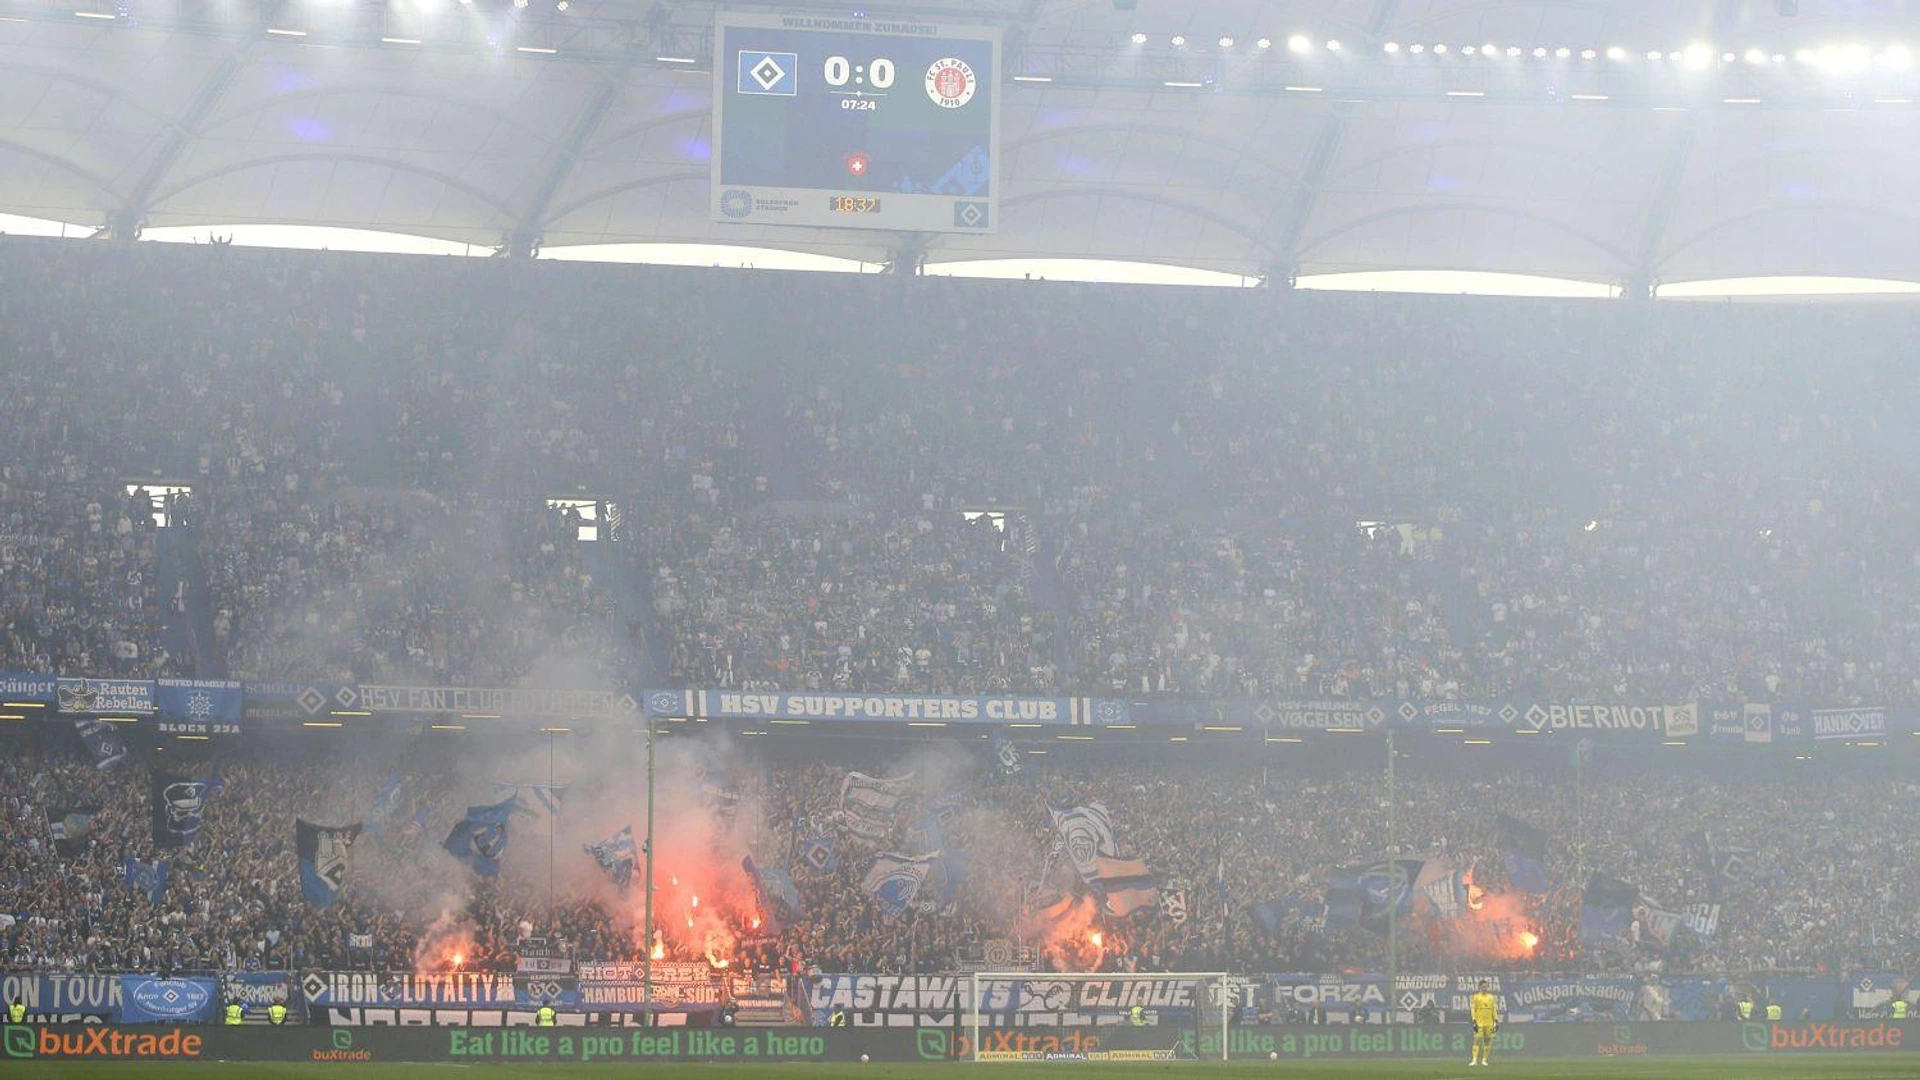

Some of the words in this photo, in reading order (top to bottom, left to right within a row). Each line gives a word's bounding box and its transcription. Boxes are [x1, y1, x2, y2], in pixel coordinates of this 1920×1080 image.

[824, 56, 895, 88] 0:0
[927, 70, 935, 80] FC
[951, 60, 973, 83] PAULI
[841, 100, 876, 110] 07:24
[940, 98, 960, 106] 1910
[836, 197, 876, 212] 18:37
[100, 682, 148, 695] Rauten
[361, 688, 400, 708] HSV
[410, 690, 446, 709] FAN
[96, 696, 152, 709] Rebellen
[721, 694, 780, 715] HSV
[788, 696, 978, 719] SUPPORTERS
[986, 699, 1058, 720] CLUB
[1424, 702, 1461, 715] PEGEL
[159, 723, 207, 733] BLOCK
[1551, 705, 1662, 730] BIERNOT
[580, 966, 632, 980] RIOT
[3, 976, 40, 1008] ON
[49, 975, 122, 1008] TOUR
[329, 974, 378, 1002] IRON
[403, 974, 494, 1003] LOYALTY
[584, 986, 646, 1004] HAMBUR
[1080, 981, 1197, 1007] CLIQUE
[1275, 983, 1385, 1003] FORZA
[1513, 981, 1635, 1006] Volksparkstadion
[40, 1027, 202, 1056] buXtrade
[450, 1030, 493, 1056] Eat
[502, 1030, 550, 1056] like
[558, 1036, 574, 1056] a
[582, 1036, 624, 1061] pro
[632, 1030, 680, 1056] feel
[688, 1030, 736, 1056] like
[744, 1036, 759, 1056] a
[767, 1030, 825, 1056] hero
[1230, 1029, 1275, 1055] like
[1281, 1036, 1296, 1054] a
[1304, 1034, 1342, 1058] pro
[1350, 1028, 1394, 1052] feel
[1400, 1028, 1444, 1052] like
[1452, 1034, 1467, 1052] a
[1771, 1024, 1902, 1048] buXtrade
[313, 1049, 371, 1060] buXtrade
[1112, 1051, 1151, 1059] ADMIRAL
